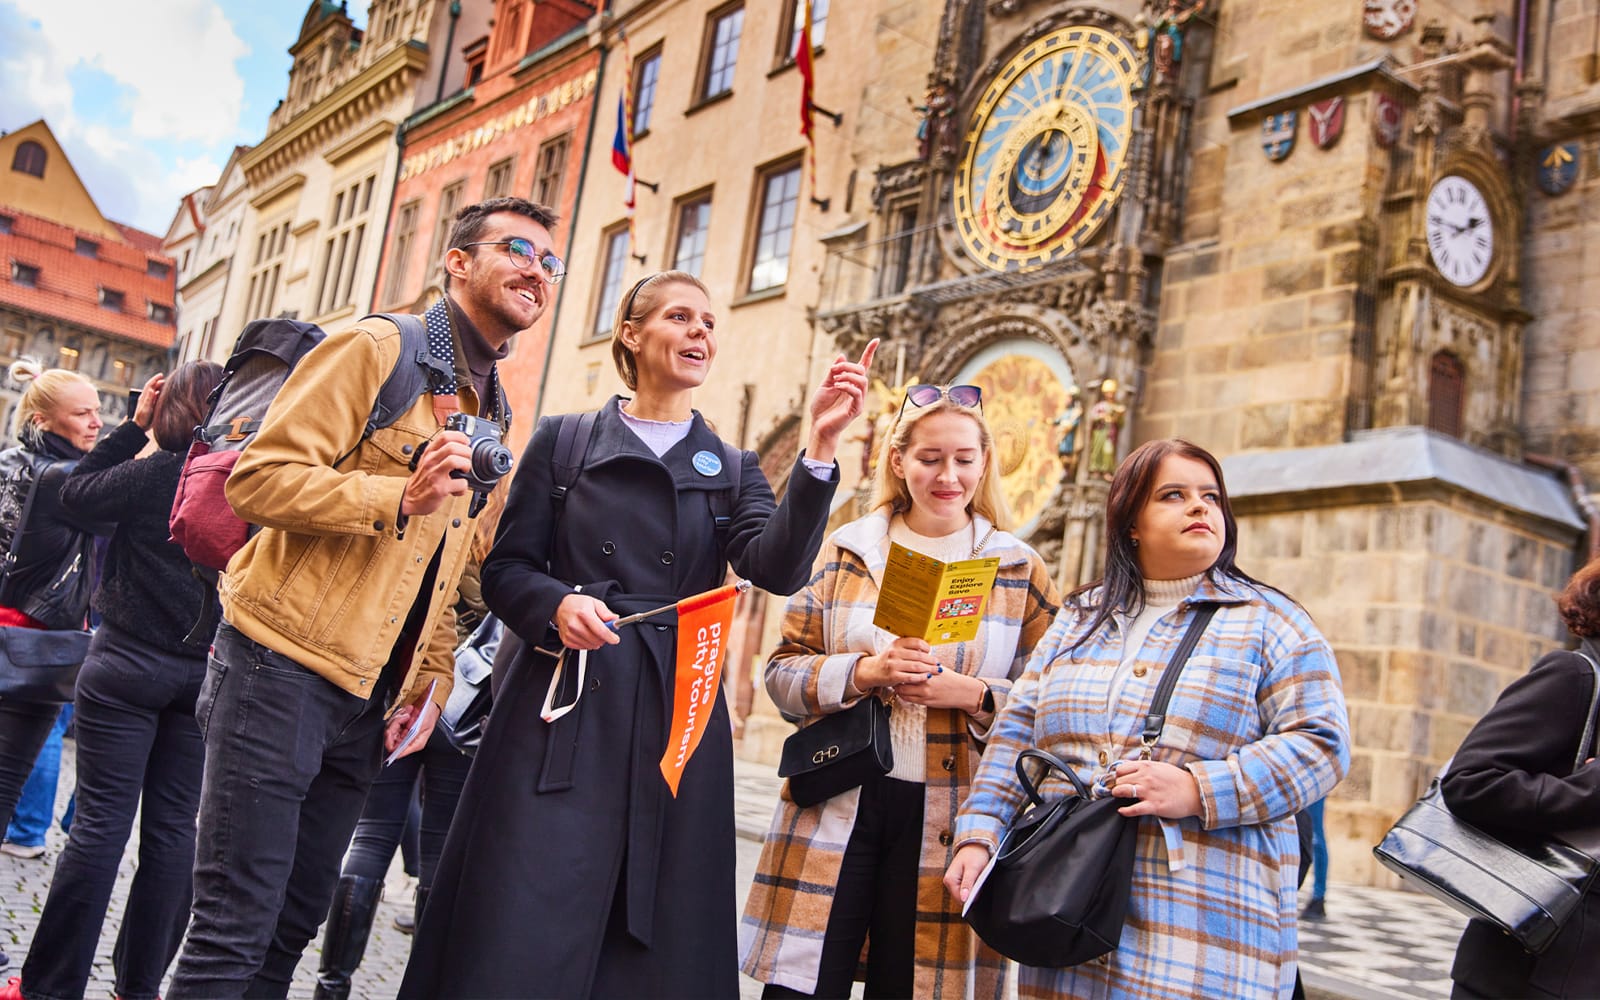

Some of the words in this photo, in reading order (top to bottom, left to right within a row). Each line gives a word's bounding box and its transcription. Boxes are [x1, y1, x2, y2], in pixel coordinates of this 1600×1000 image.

[950, 582, 983, 590] Explore
[951, 577, 975, 585] Enjoy
[692, 627, 709, 671] city
[702, 622, 722, 705] prague
[674, 676, 702, 768] tourism
